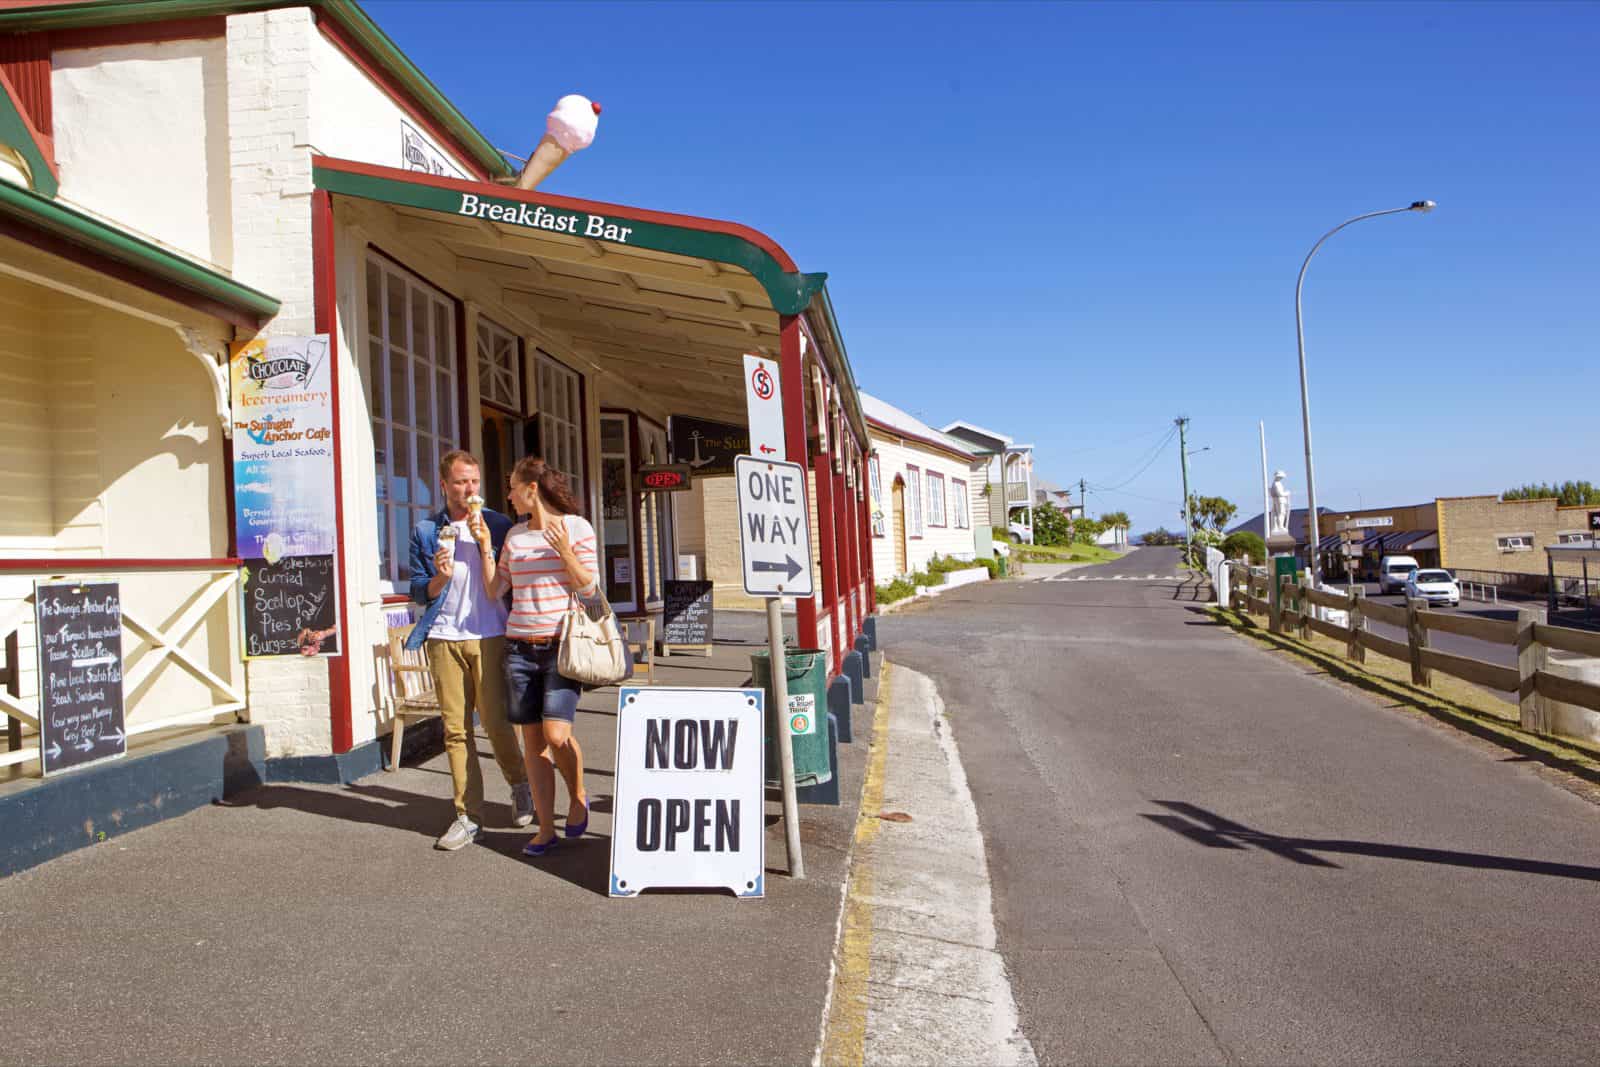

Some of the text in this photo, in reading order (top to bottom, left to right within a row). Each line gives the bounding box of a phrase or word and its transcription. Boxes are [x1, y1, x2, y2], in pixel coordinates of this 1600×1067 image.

[458, 193, 632, 243] Breakfast Bar
[251, 360, 306, 379] CHOCOLATE
[264, 427, 330, 442] Anchor Cafe
[645, 471, 681, 487] OPEN
[749, 471, 796, 505] ONE
[748, 512, 800, 545] WAY
[258, 568, 303, 587] Curried
[254, 587, 305, 614] Scallop
[260, 612, 291, 639] Pies
[644, 718, 739, 770] NOW
[636, 798, 741, 852] OPEN
